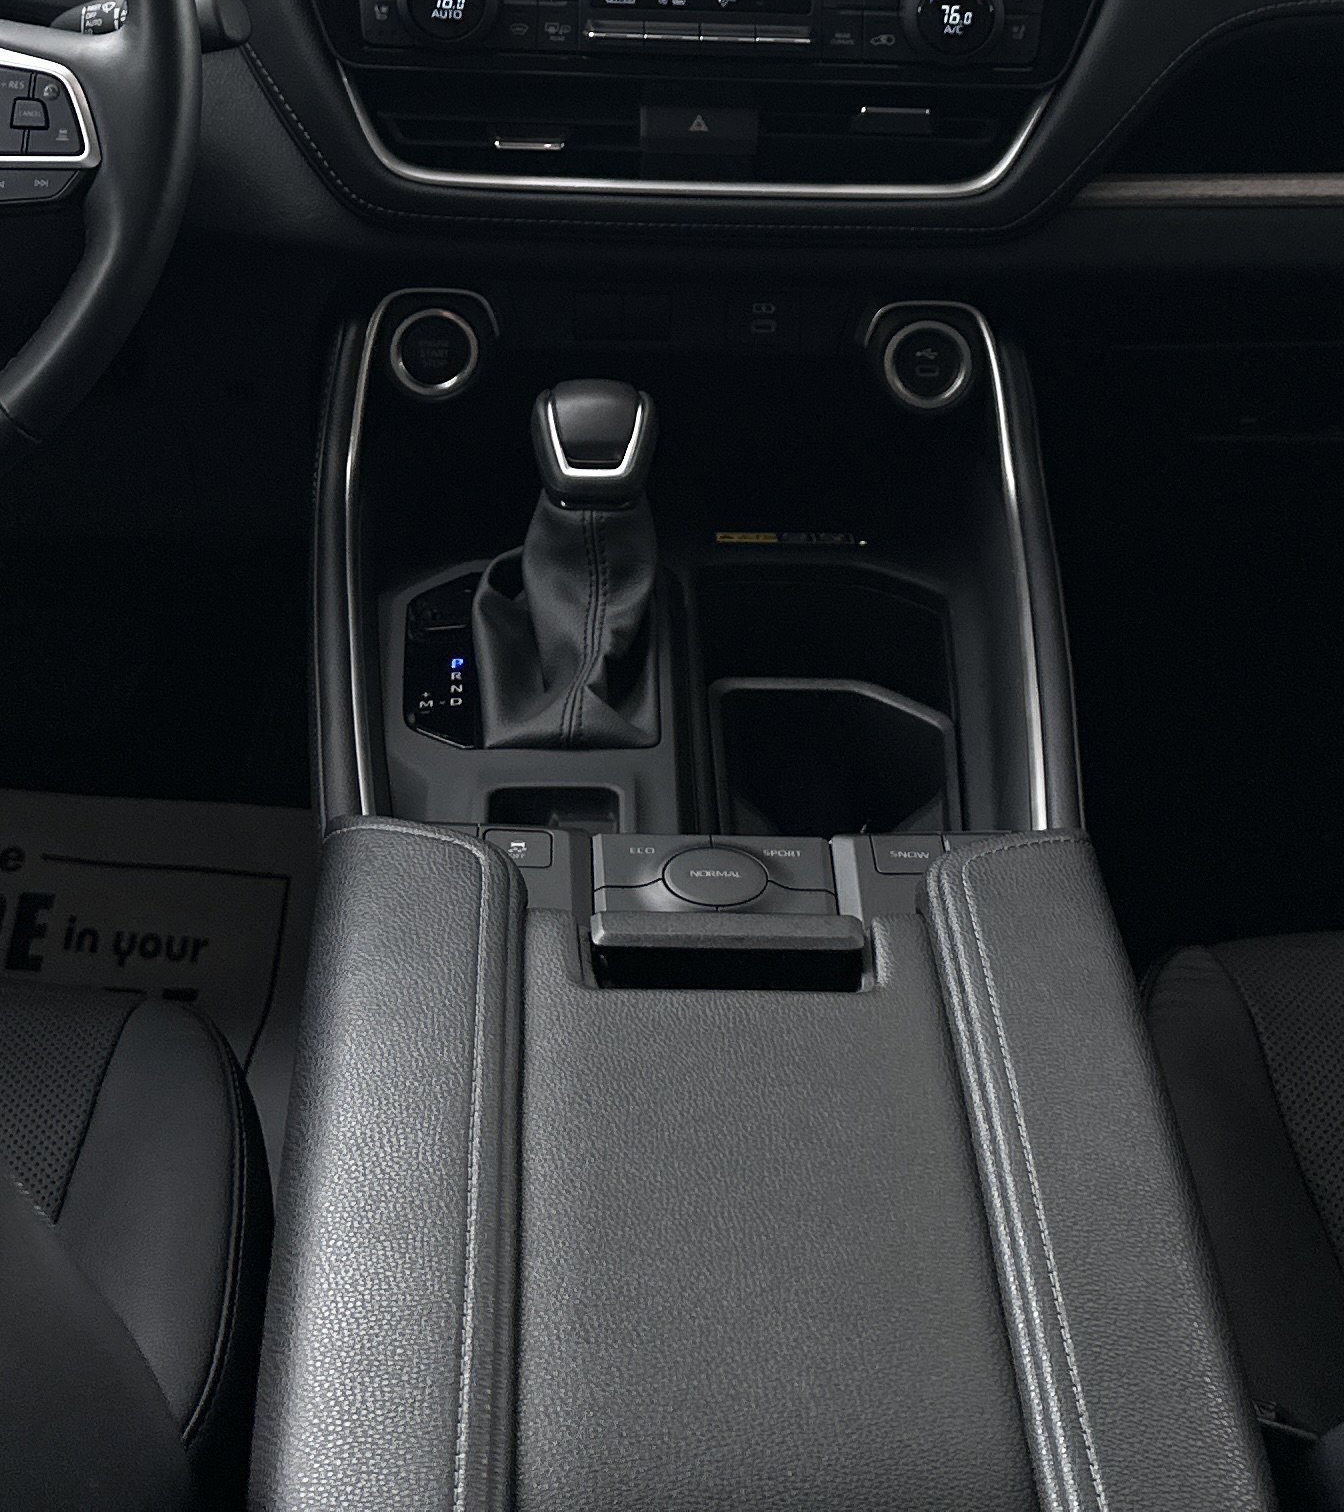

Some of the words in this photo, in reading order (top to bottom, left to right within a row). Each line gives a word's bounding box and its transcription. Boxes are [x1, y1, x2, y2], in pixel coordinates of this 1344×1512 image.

[431, 9, 463, 20] AUTO
[941, 4, 973, 26] 76.0
[943, 25, 964, 35] A/C
[450, 657, 464, 669] P
[450, 671, 463, 681] R
[449, 684, 464, 694] N
[419, 699, 434, 709] M
[449, 697, 464, 706] D
[629, 846, 656, 855] ECO
[762, 847, 802, 858] SPORT
[889, 850, 931, 859] SNOW
[688, 869, 743, 879] NORMAL
[63, 915, 99, 955] in
[113, 927, 209, 967] your
